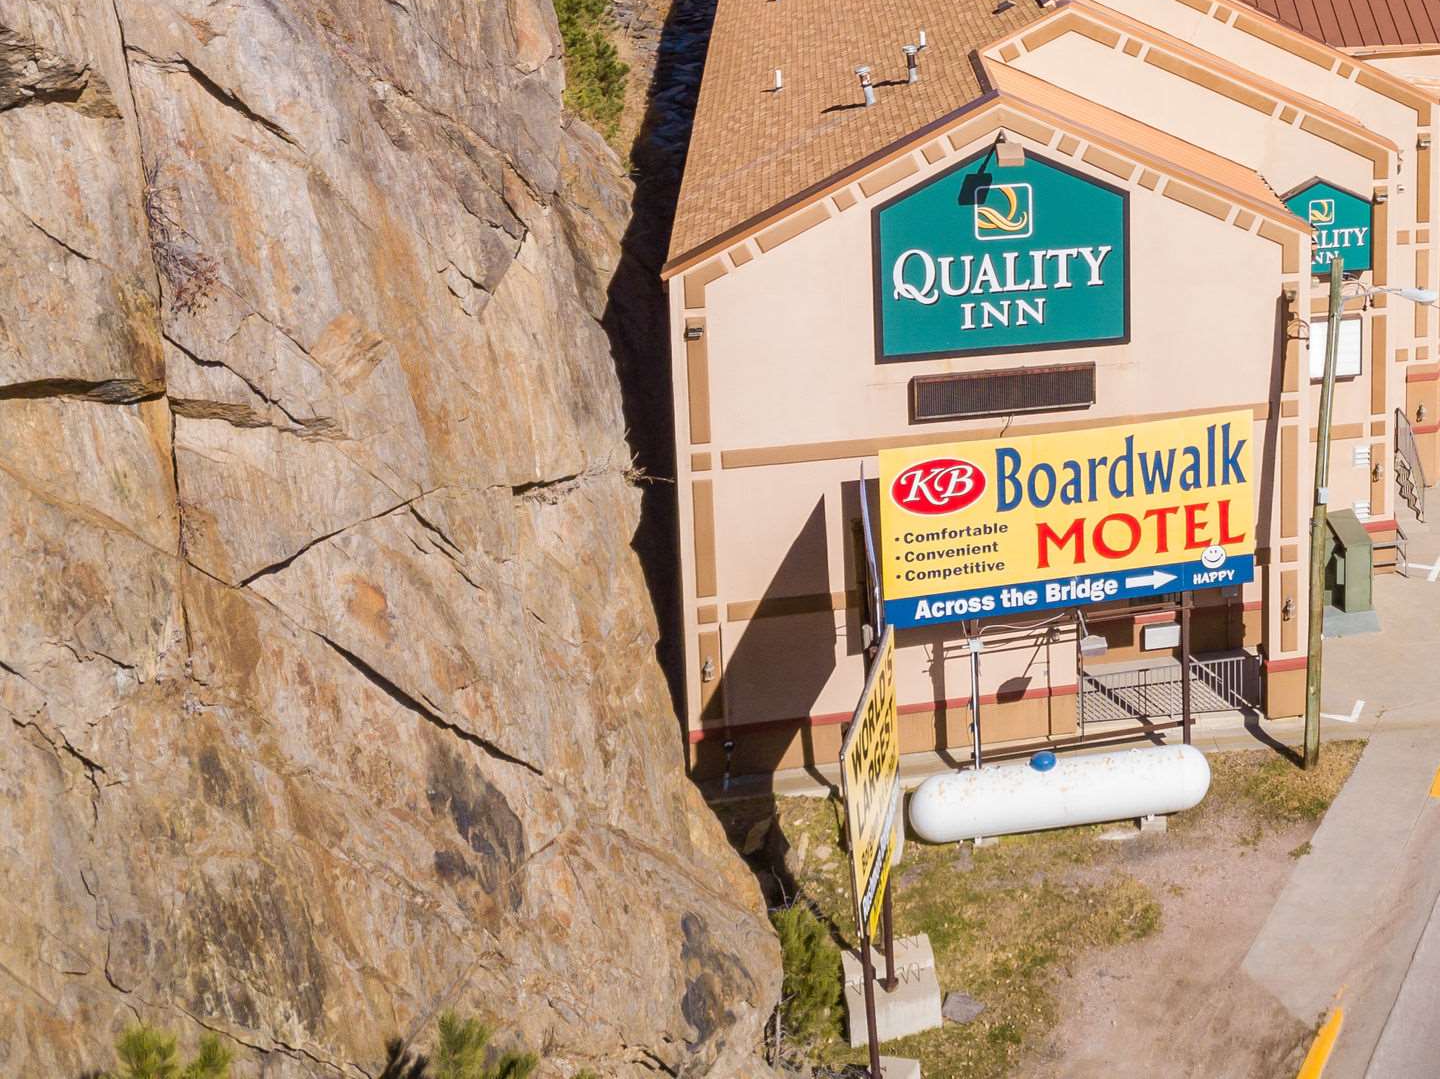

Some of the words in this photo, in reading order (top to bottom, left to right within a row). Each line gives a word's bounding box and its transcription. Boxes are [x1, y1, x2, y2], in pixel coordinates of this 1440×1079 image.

[893, 245, 1112, 305] QUALITY
[960, 298, 1046, 330] INN
[900, 463, 974, 506] KB
[994, 422, 1249, 513] Boardwalk
[903, 522, 1009, 545] Comfortable
[904, 541, 999, 563] Convenient
[1035, 499, 1247, 570] MOTEL
[905, 561, 1006, 582] Competitive
[1193, 569, 1236, 585] HAPPY
[914, 594, 996, 621] Across
[1000, 587, 1040, 608] the
[1045, 576, 1119, 602] Bridge
[851, 644, 893, 784] WORLD'S
[856, 694, 894, 840] LARGEST
